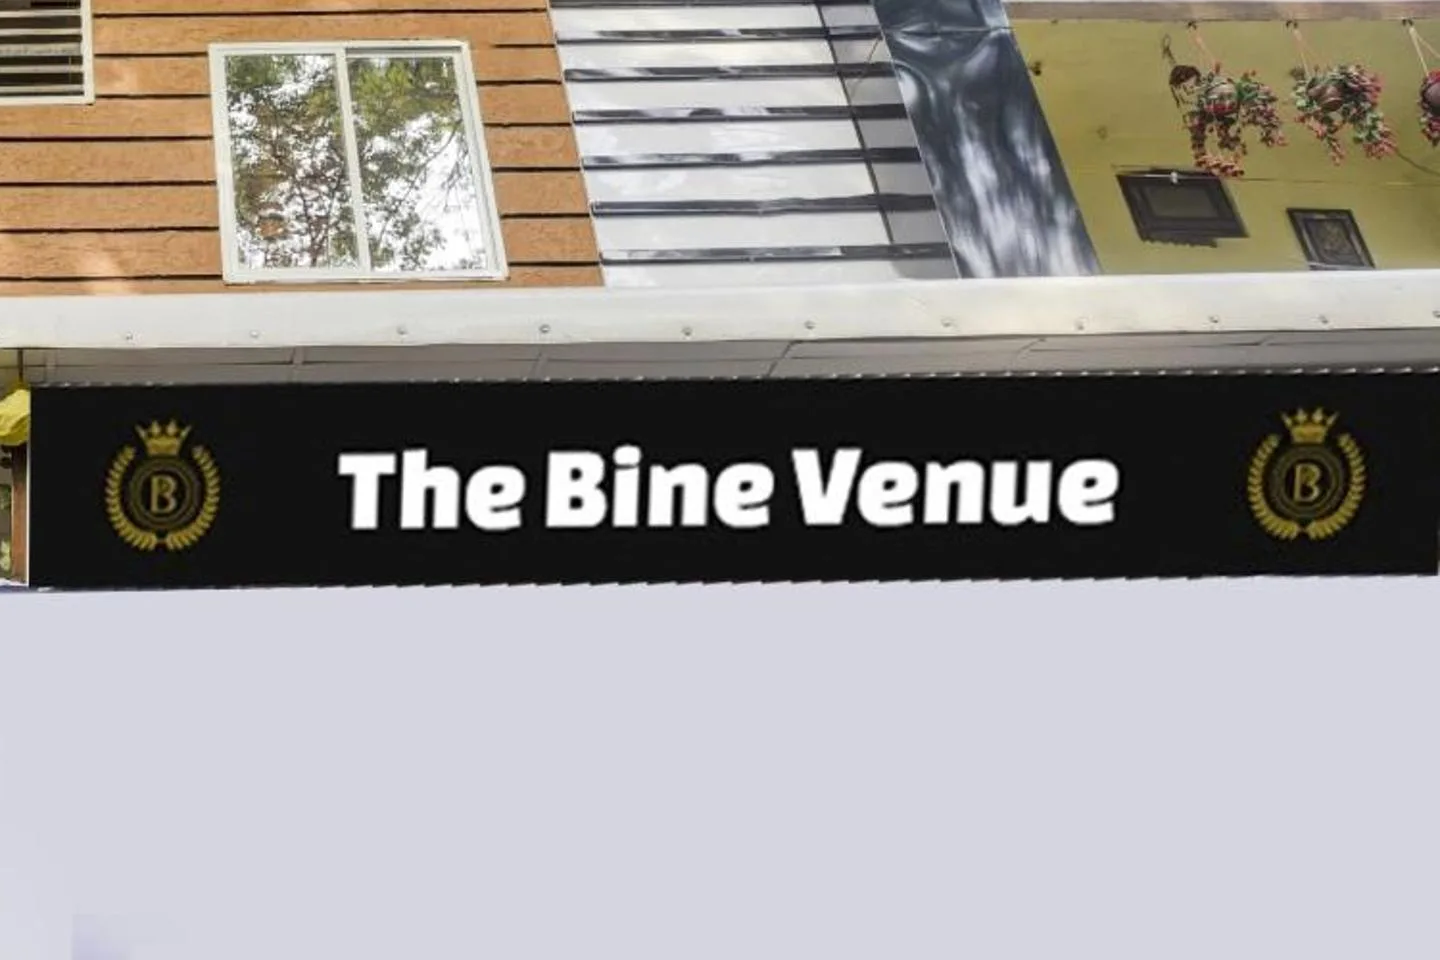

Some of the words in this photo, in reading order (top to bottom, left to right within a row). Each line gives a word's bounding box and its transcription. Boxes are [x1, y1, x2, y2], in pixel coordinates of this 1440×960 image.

[338, 448, 526, 531] The
[545, 444, 775, 528] Bine
[791, 448, 1119, 527] Venue
